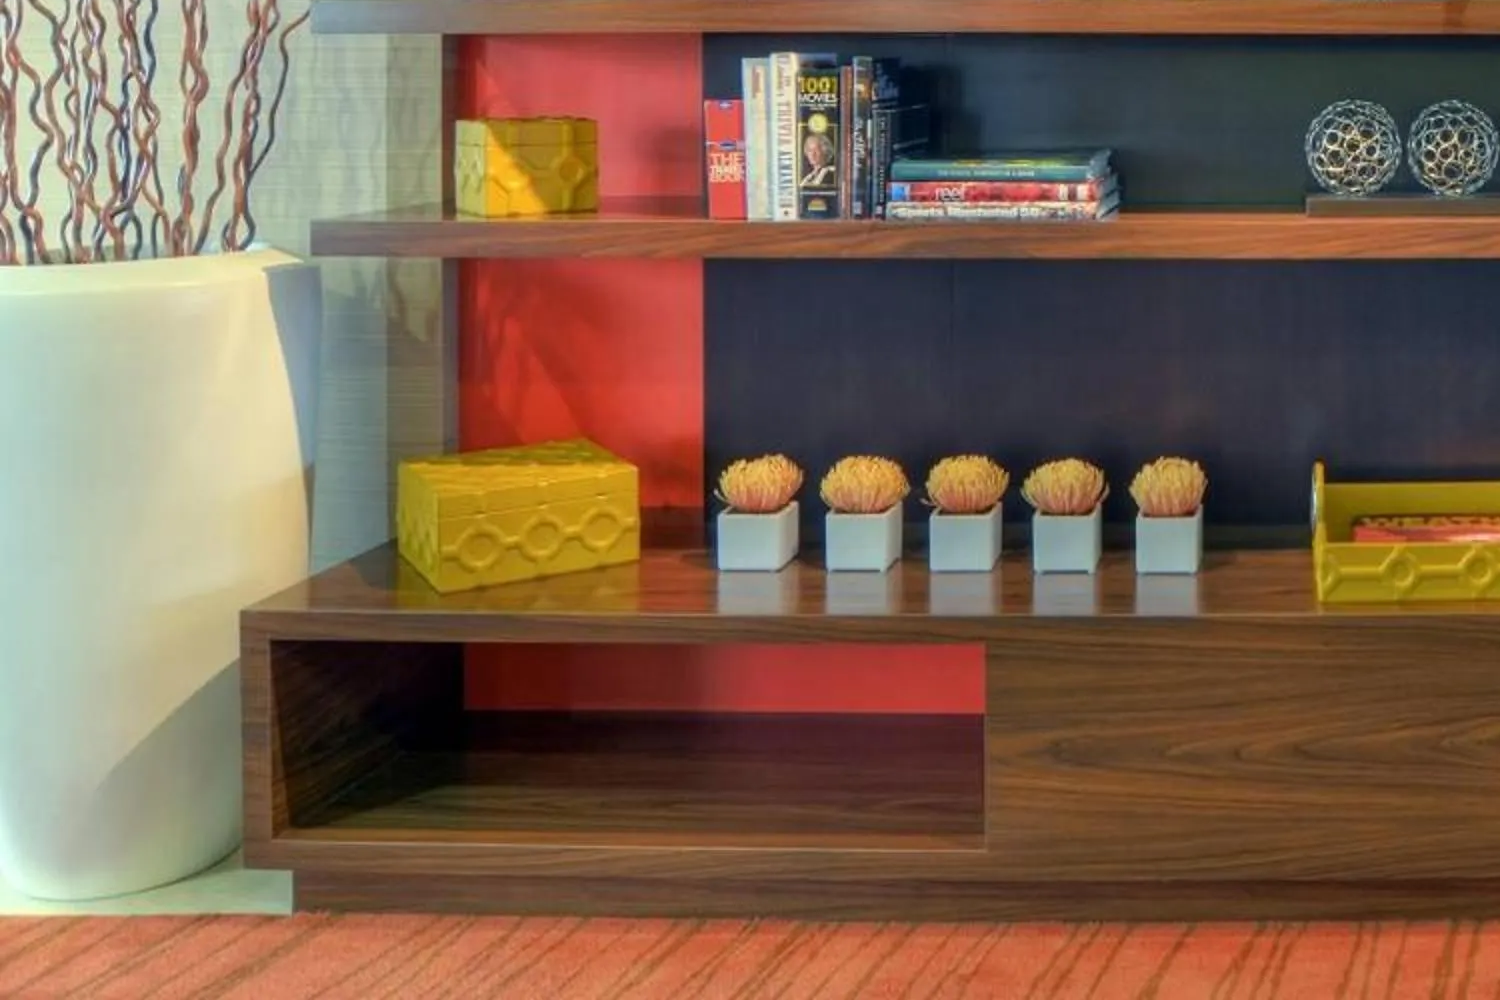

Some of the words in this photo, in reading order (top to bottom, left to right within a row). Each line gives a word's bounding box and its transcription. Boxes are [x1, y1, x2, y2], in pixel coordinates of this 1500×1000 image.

[798, 76, 837, 93] 1001
[798, 93, 838, 102] MOVIES
[710, 153, 743, 165] THE
